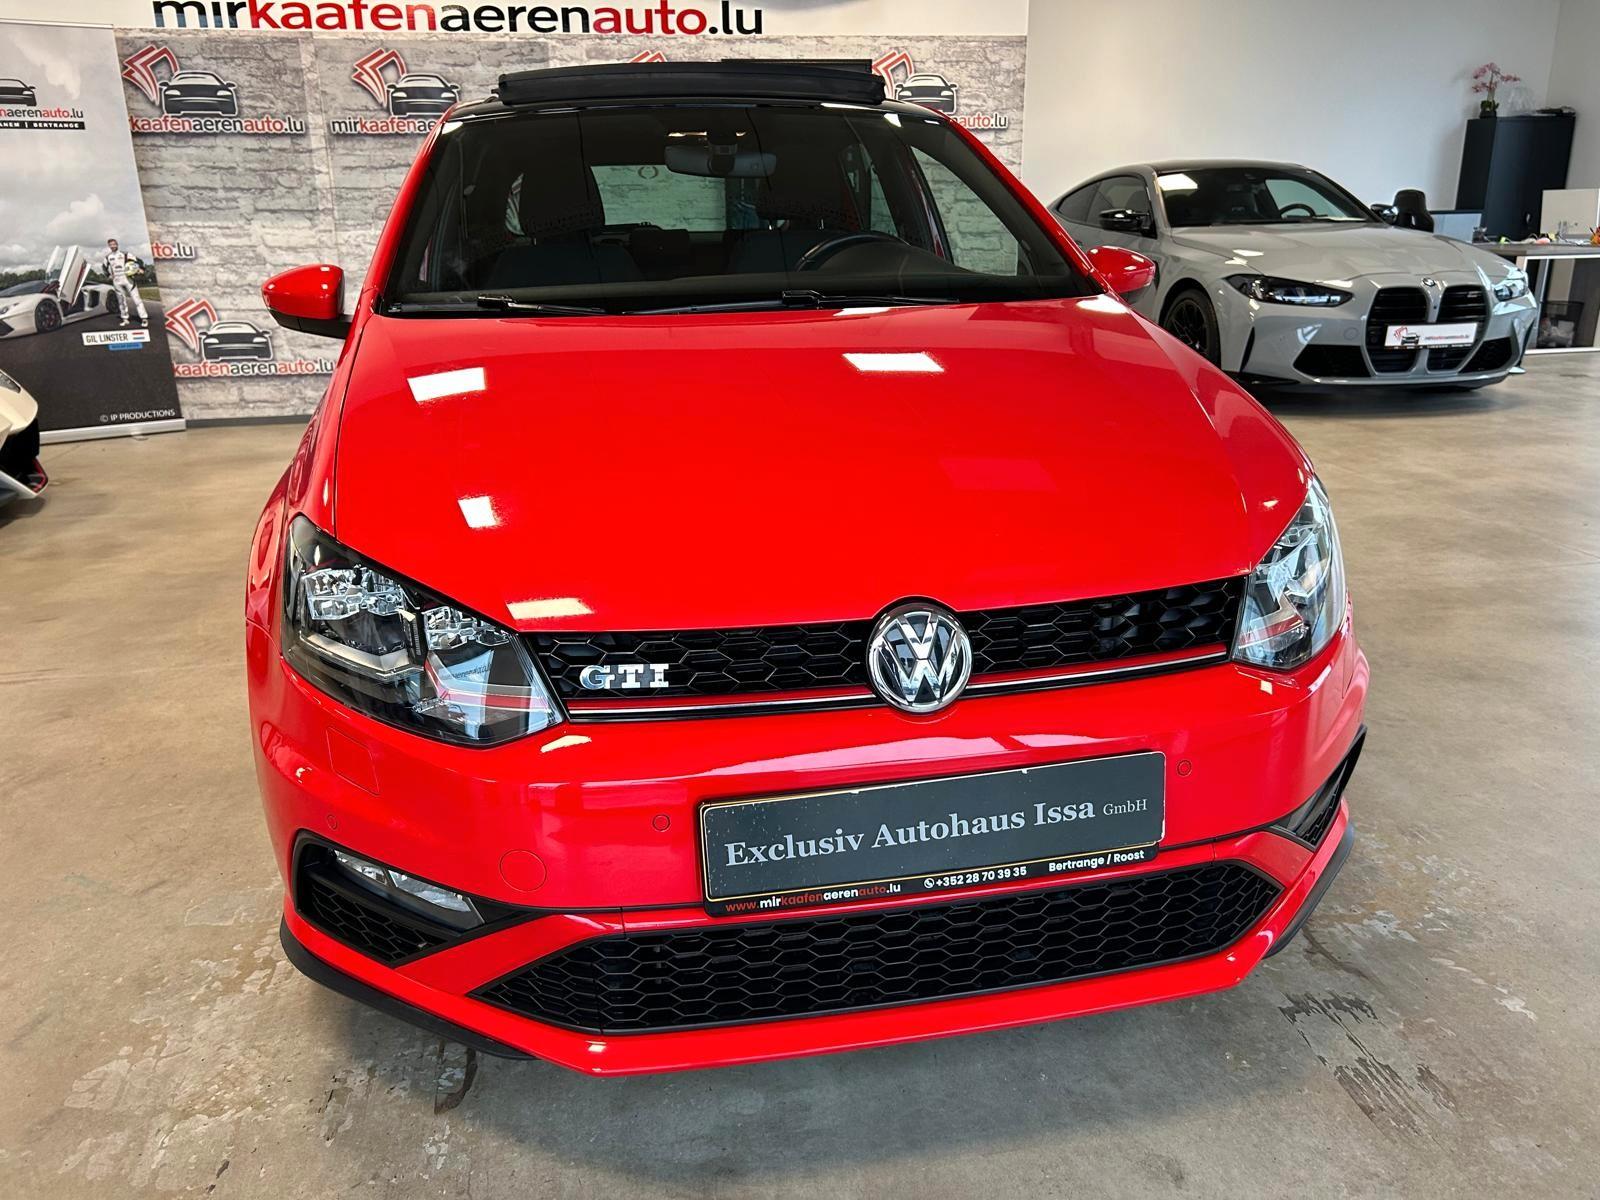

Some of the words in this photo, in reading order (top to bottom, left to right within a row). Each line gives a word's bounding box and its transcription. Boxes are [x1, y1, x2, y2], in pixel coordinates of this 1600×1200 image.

[152, 0, 763, 35] mirkaafenaerenauto.lu
[85, 334, 98, 343] GIL
[99, 333, 129, 343] LINSTER
[119, 409, 176, 420] PRODUCTIONS
[579, 663, 670, 690] GTI
[724, 828, 864, 867] Exclusiv
[871, 810, 1026, 849] Autohaus
[1033, 802, 1096, 827] Issa
[1103, 799, 1149, 816] GmbH
[725, 883, 902, 912] www.mirkaafenaerenauto.lu
[936, 876, 964, 888] +352
[965, 874, 980, 886] 28
[982, 871, 996, 882] 70
[997, 869, 1011, 880] 39
[1013, 866, 1028, 878] 35
[1048, 855, 1105, 873] Bertrange
[1113, 850, 1145, 863] Roost
